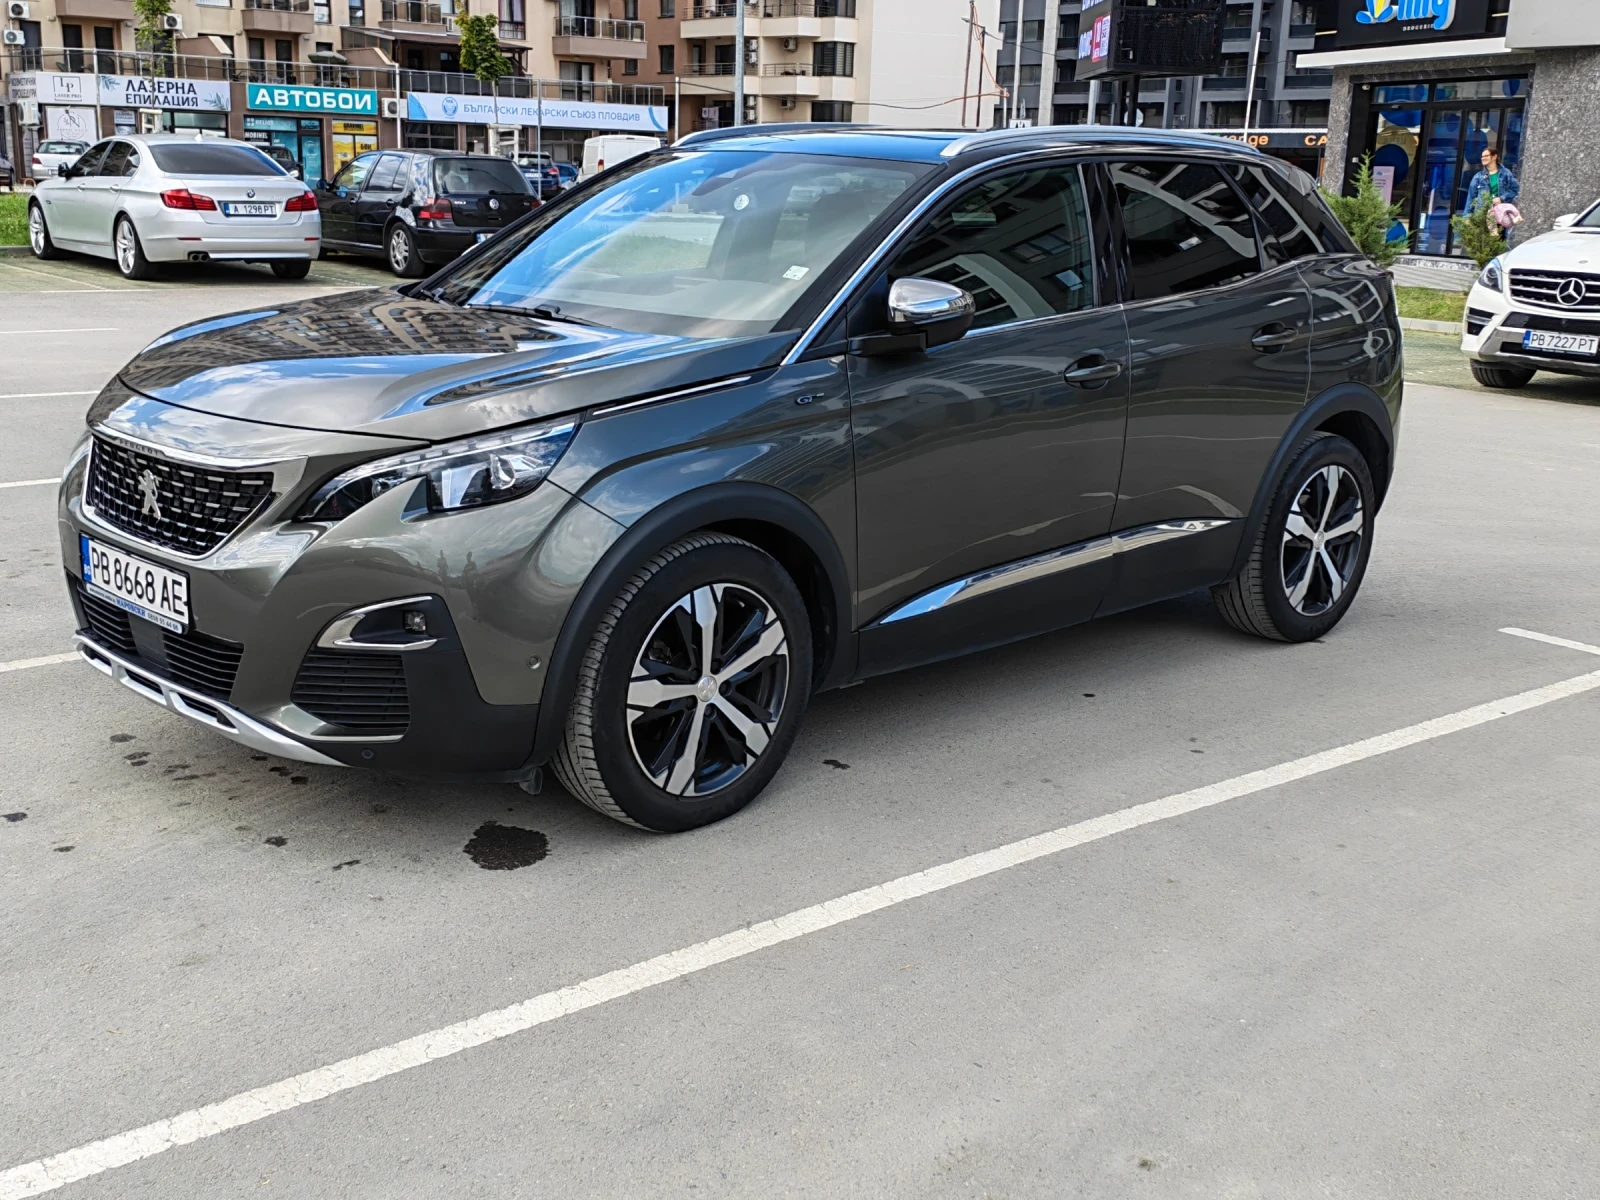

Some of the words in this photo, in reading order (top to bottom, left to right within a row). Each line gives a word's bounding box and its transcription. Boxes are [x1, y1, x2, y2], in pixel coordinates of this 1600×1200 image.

[125, 80, 197, 95] ЛАЗЕРНА
[125, 93, 199, 107] ЕПИЛАЦИЯ
[255, 88, 372, 110] АВТОБОИ
[570, 109, 596, 119] СЪЮЗ
[598, 111, 641, 122] ПЛОВДИВ
[1531, 333, 1545, 346] PB
[1547, 335, 1577, 348] 7227
[1578, 338, 1596, 351] PT
[119, 438, 159, 456] PEUGEOT
[92, 547, 110, 585] PB
[114, 557, 156, 604] 8668
[160, 575, 185, 616] AE
